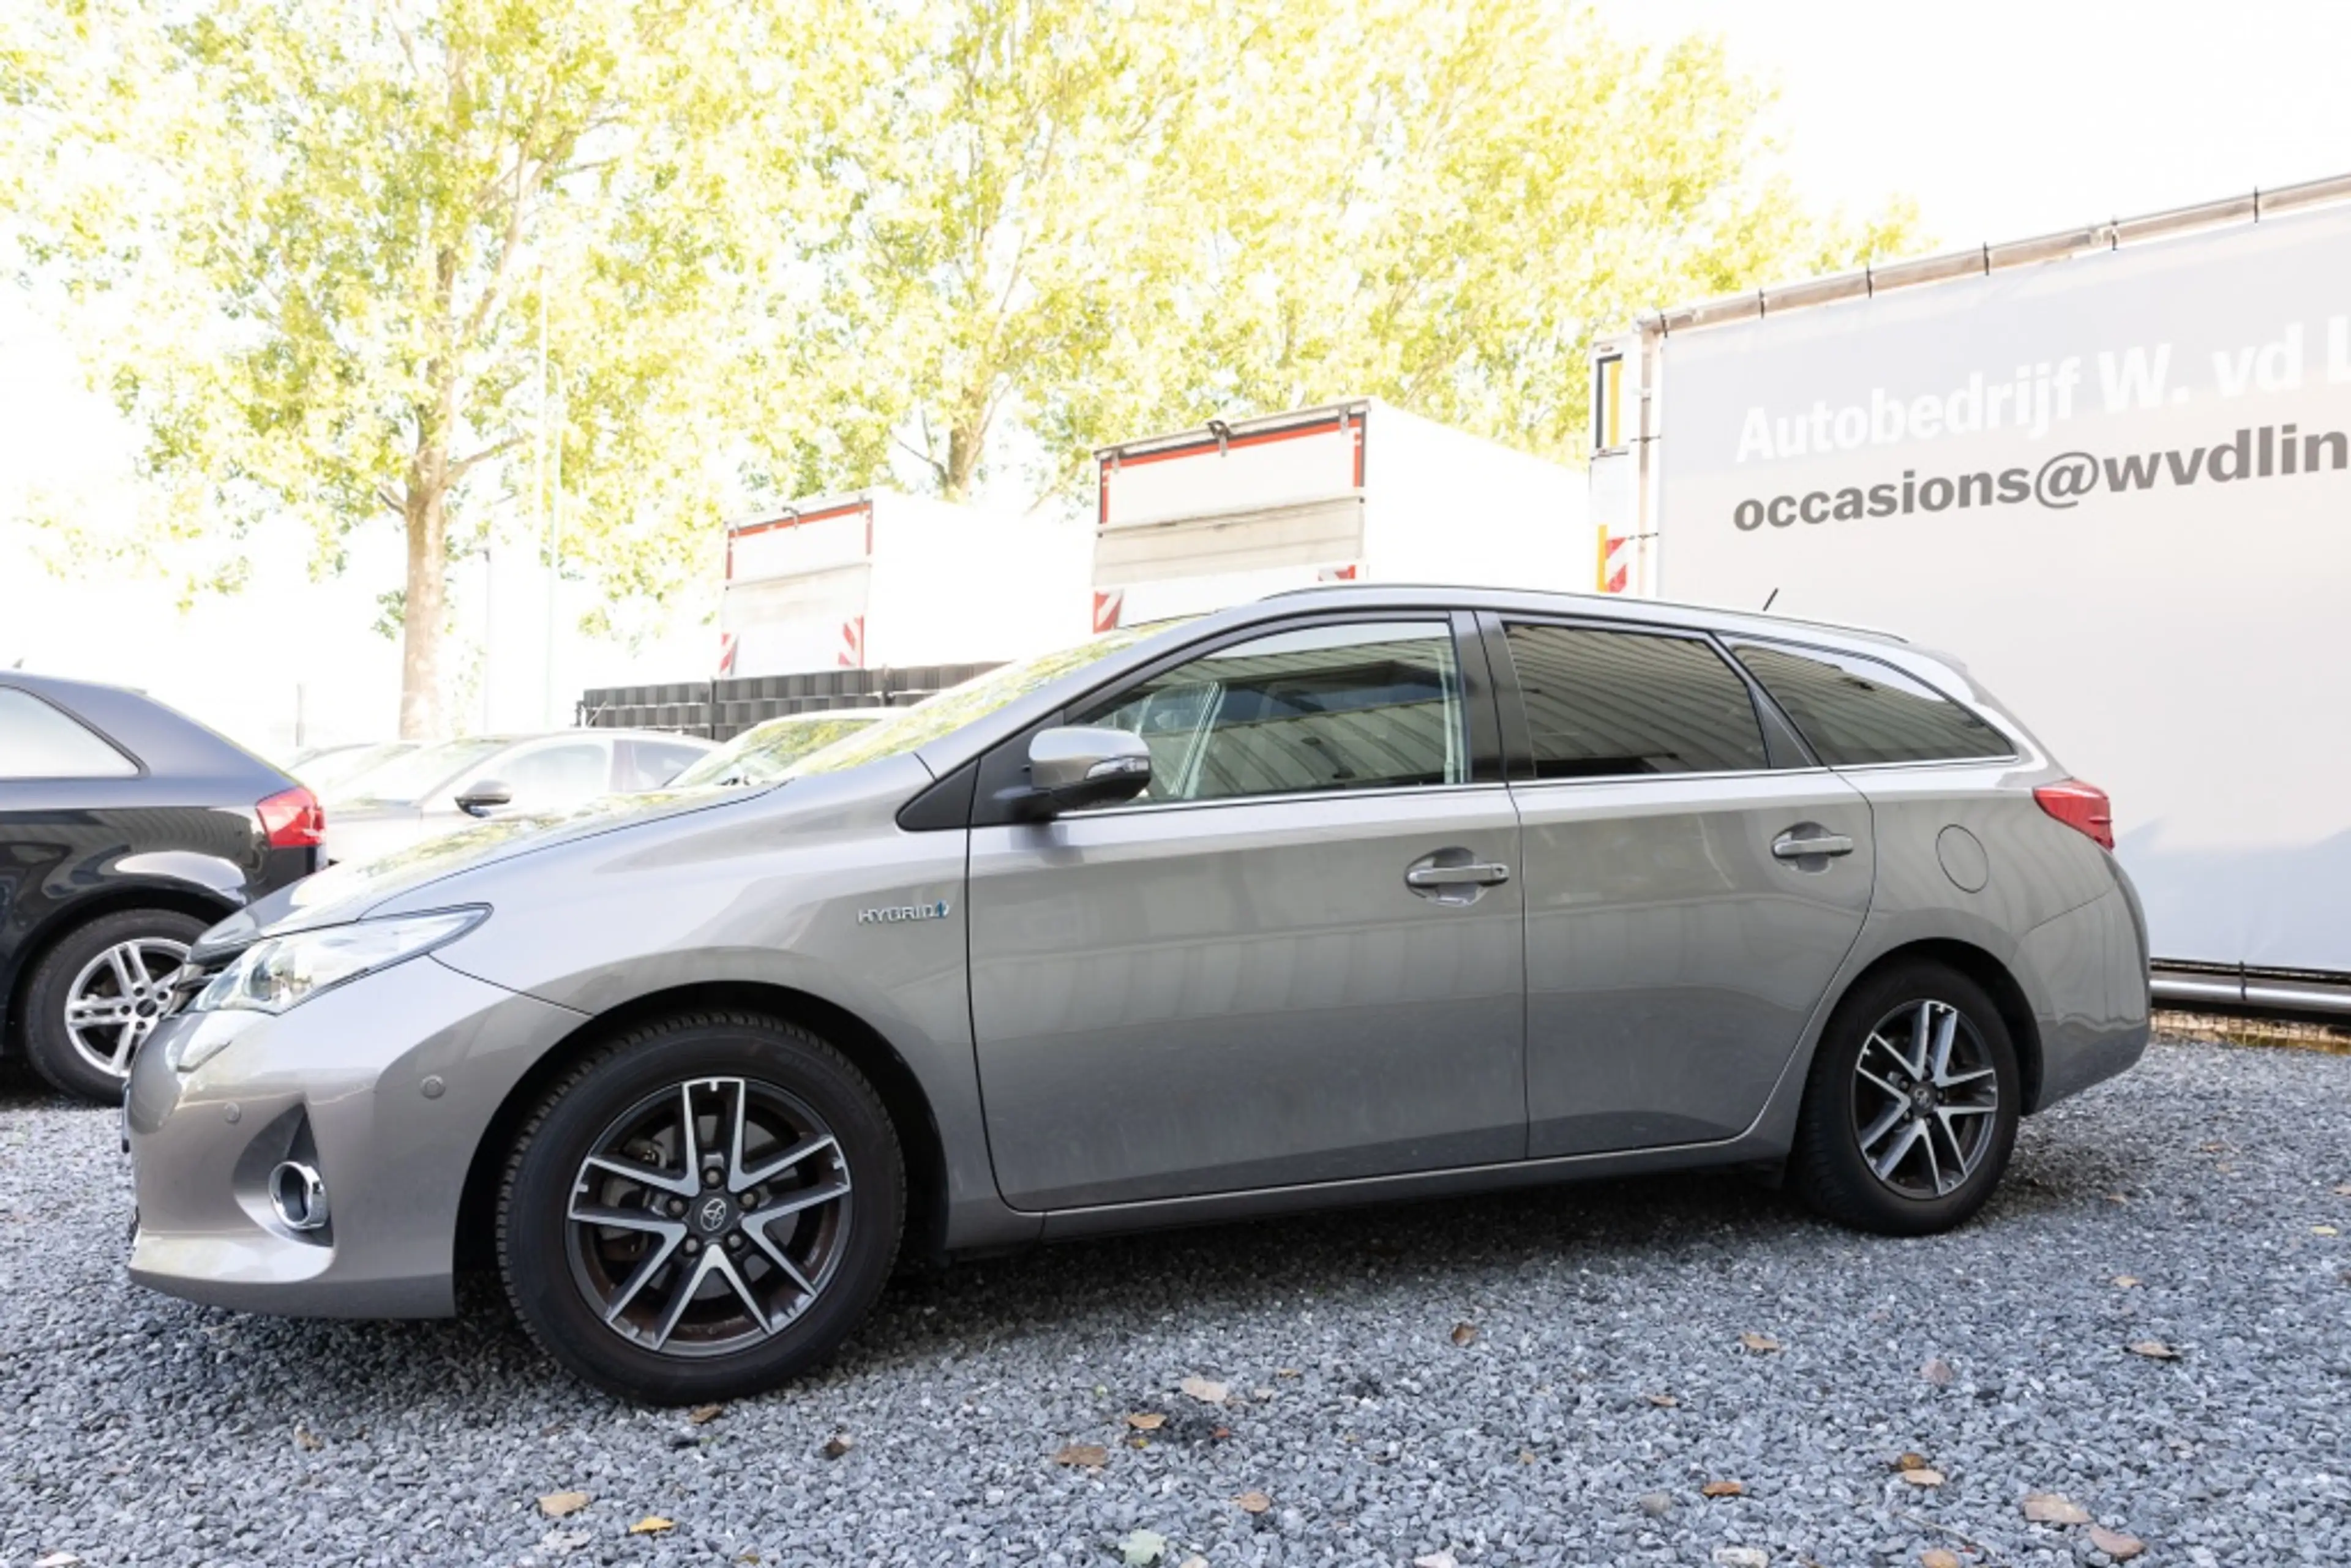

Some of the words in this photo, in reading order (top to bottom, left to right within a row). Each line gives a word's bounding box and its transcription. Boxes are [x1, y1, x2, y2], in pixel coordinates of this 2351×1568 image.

[1735, 355, 2082, 463] Autobedrijf
[2098, 343, 2190, 413] W.
[2211, 320, 2304, 398] vd
[1733, 423, 2349, 531] occasions@wvdlin
[857, 903, 937, 925] HYBRID
